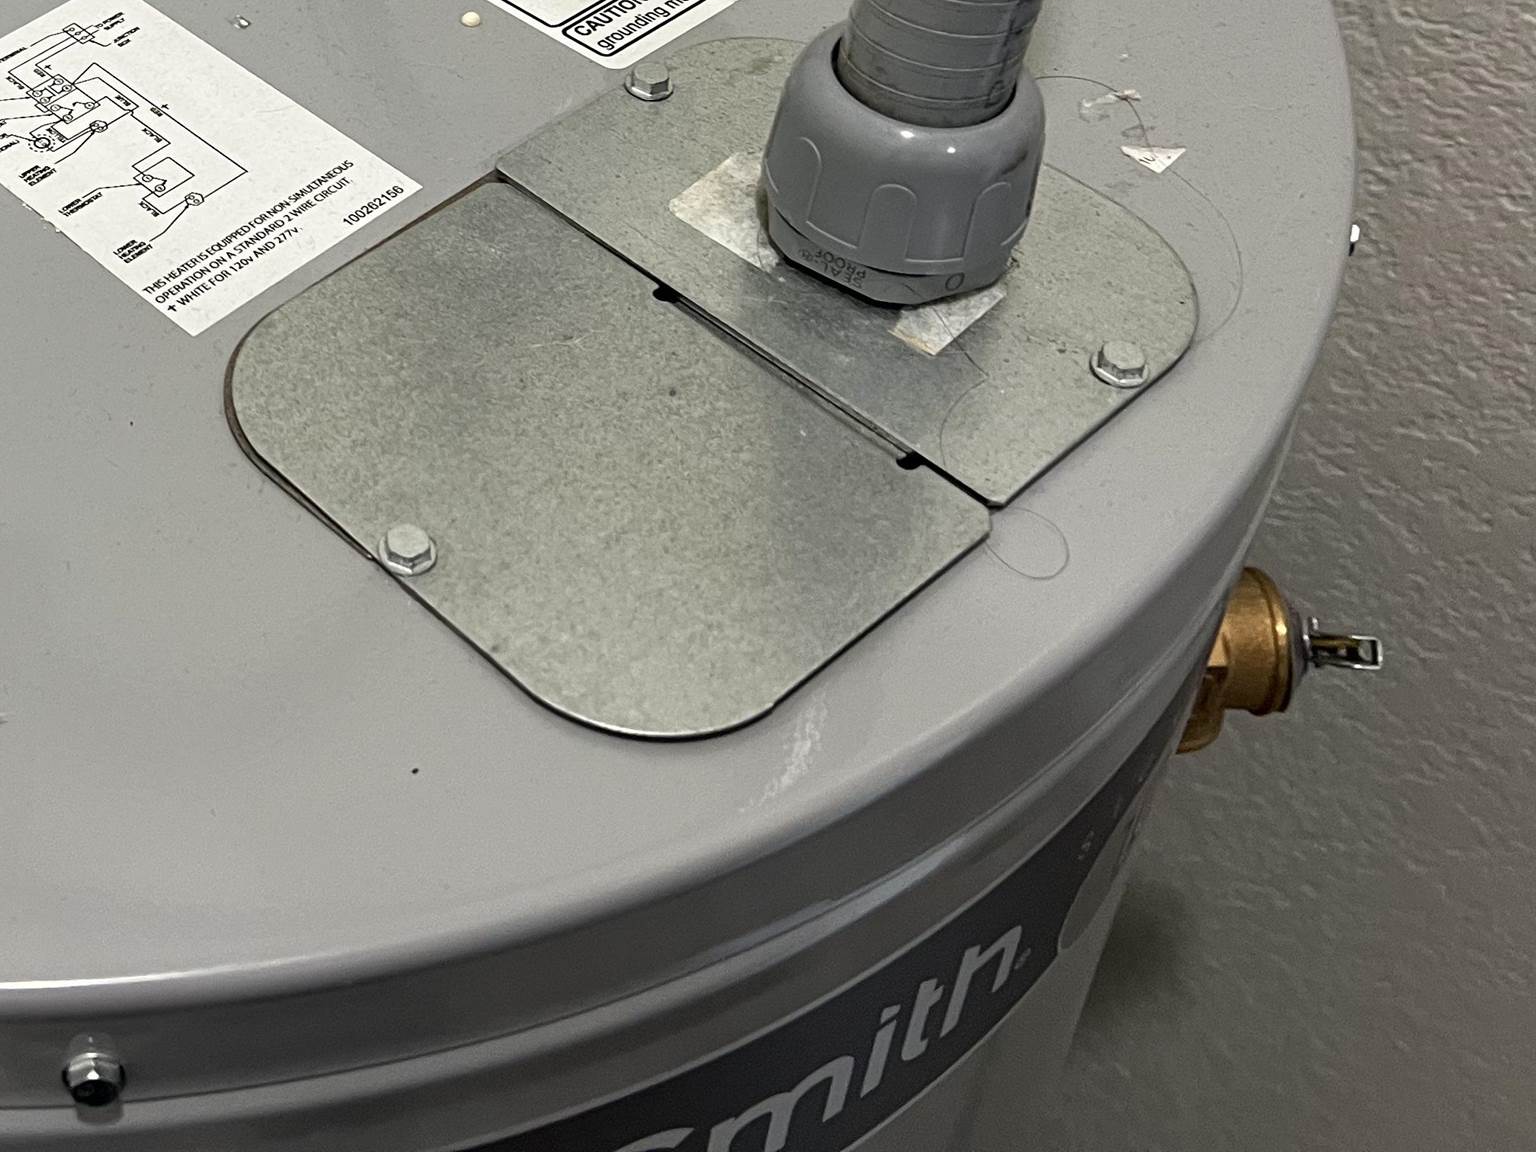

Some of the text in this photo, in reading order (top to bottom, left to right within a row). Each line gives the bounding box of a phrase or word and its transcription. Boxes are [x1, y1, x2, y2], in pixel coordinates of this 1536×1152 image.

[597, 6, 670, 50] grounding
[343, 185, 403, 225] 100262156
[142, 278, 166, 294] THIS
[163, 258, 199, 281] HEATER
[195, 252, 209, 260] IS
[205, 225, 250, 255] EQUIPPED
[247, 213, 270, 228] FOR
[155, 266, 210, 303] OPERATION
[208, 255, 227, 268] ON
[225, 251, 236, 259] A
[233, 219, 284, 253] STANDARD
[288, 199, 316, 216] WIRE
[176, 282, 211, 305] WHITE
[207, 269, 231, 286] FOR
[228, 255, 253, 271] 120v
[252, 241, 275, 258] AND
[611, 927, 1022, 1152] mith
